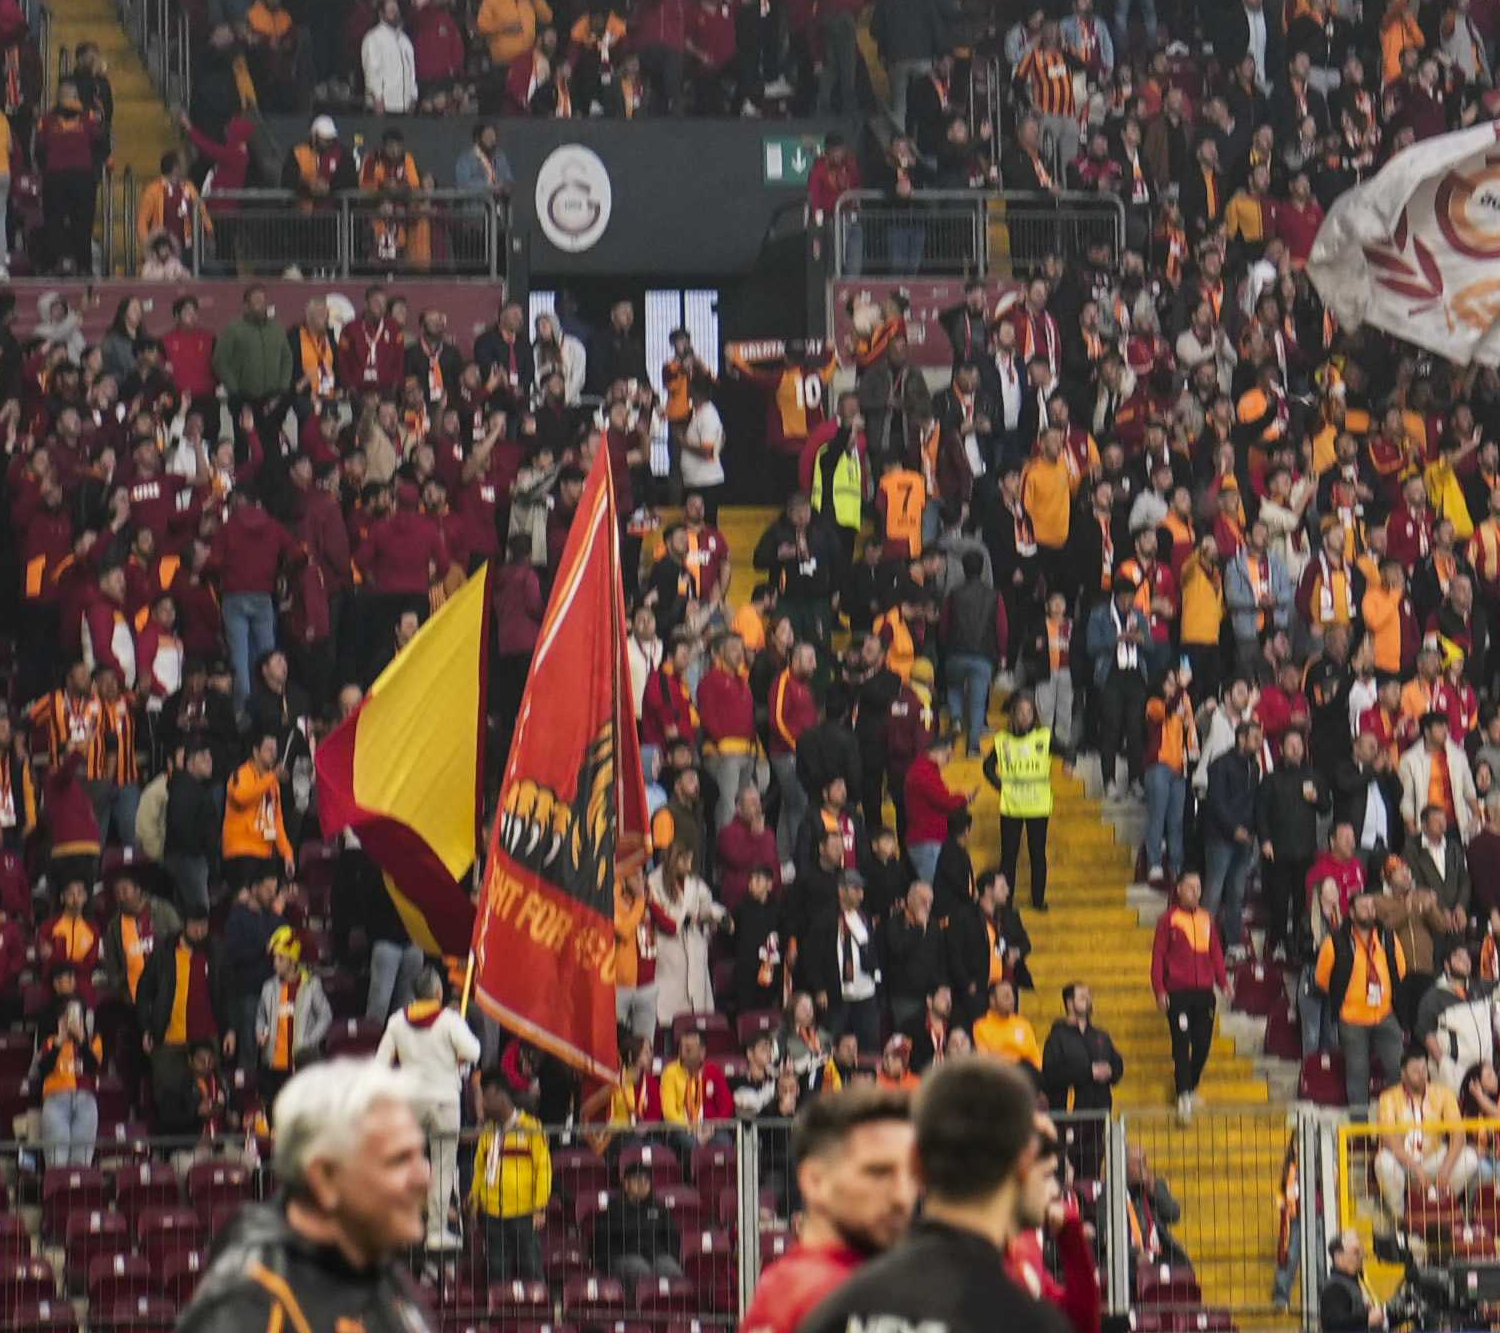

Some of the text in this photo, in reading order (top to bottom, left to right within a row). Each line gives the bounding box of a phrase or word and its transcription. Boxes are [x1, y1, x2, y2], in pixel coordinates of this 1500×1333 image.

[792, 372, 822, 410] 10
[897, 483, 914, 517] 7
[514, 888, 574, 952] FOR
